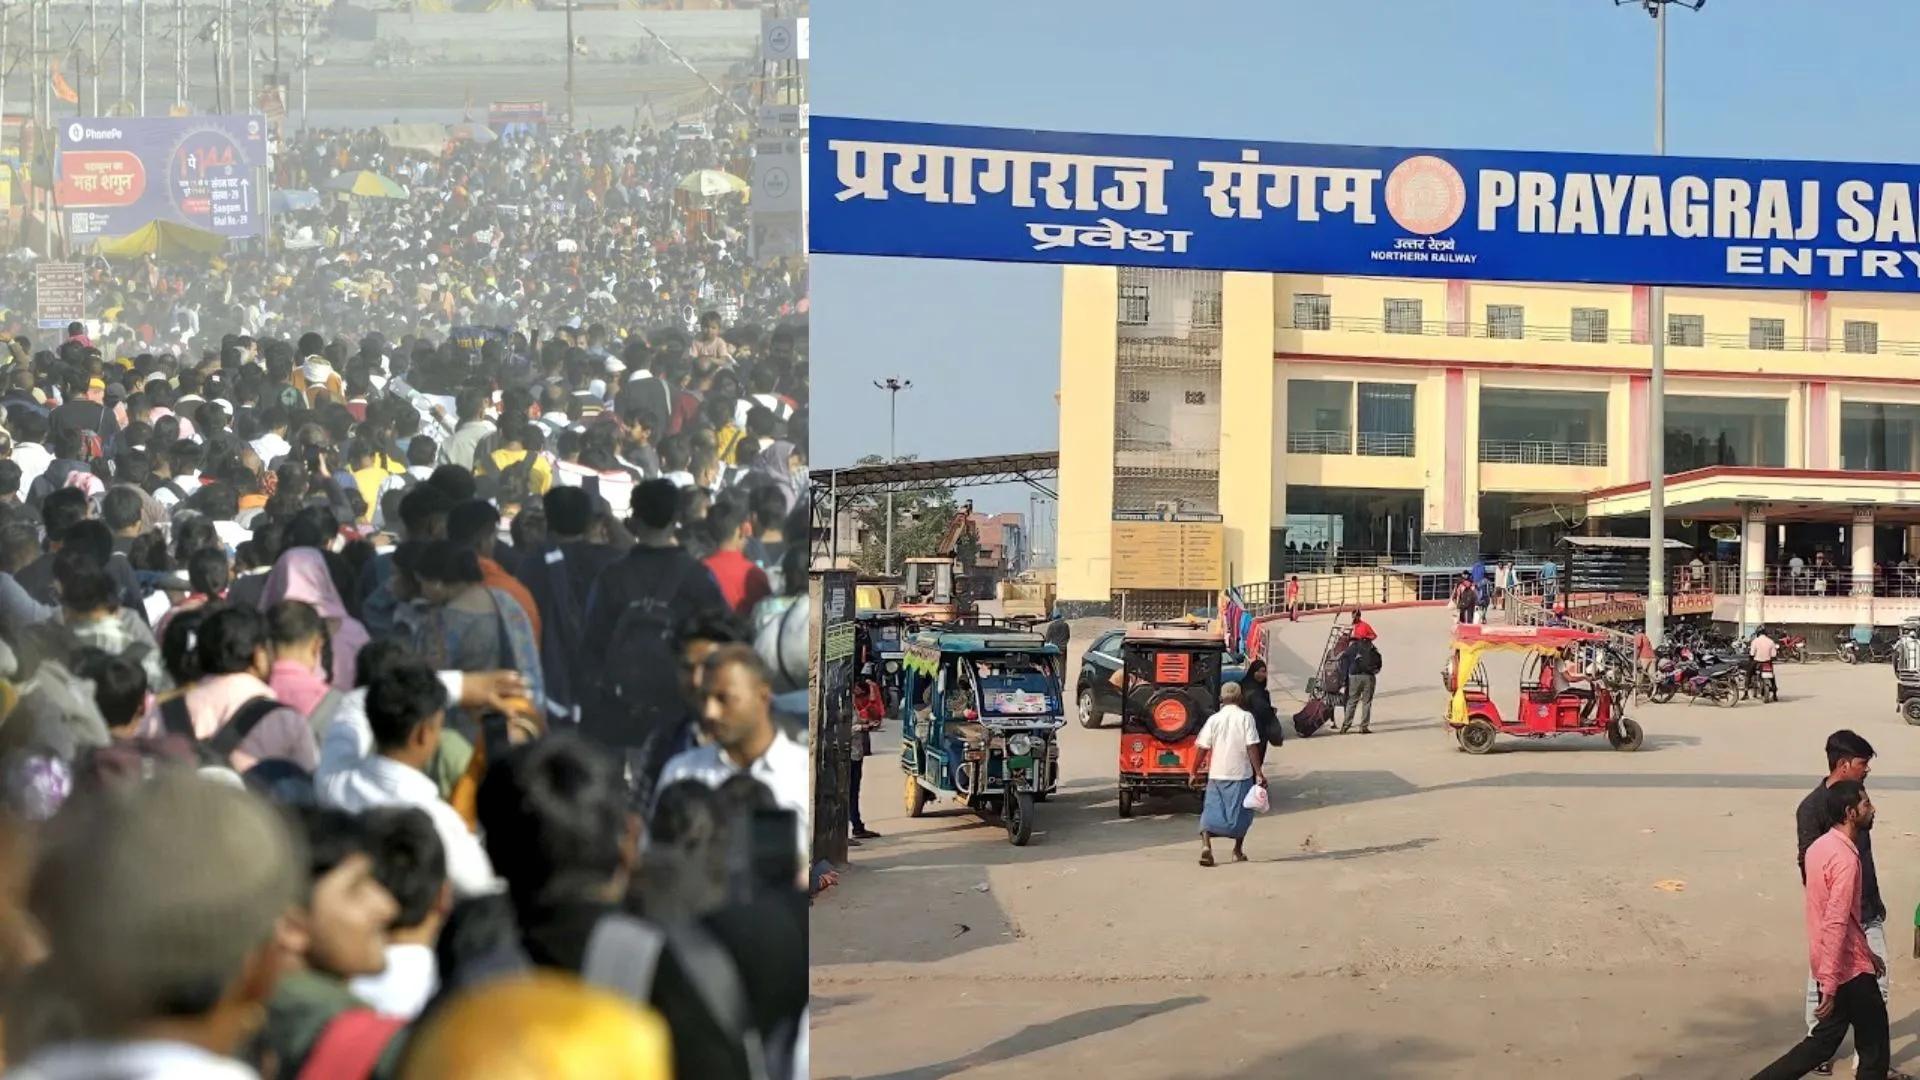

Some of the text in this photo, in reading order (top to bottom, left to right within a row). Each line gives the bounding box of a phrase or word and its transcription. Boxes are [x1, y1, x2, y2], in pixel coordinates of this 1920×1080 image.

[85, 127, 122, 140] PhonePe
[70, 172, 136, 196] महा शगुन
[828, 139, 1174, 215] प्रयागराज
[1198, 149, 1383, 224] संगम
[1478, 169, 1820, 241] PRAYAGRAJ
[1837, 181, 1920, 243] SA
[1025, 218, 1194, 253] प्रवेश
[1393, 236, 1456, 251] उत्तर रेलवे
[1370, 250, 1478, 264] NORTHERN RAILWAY
